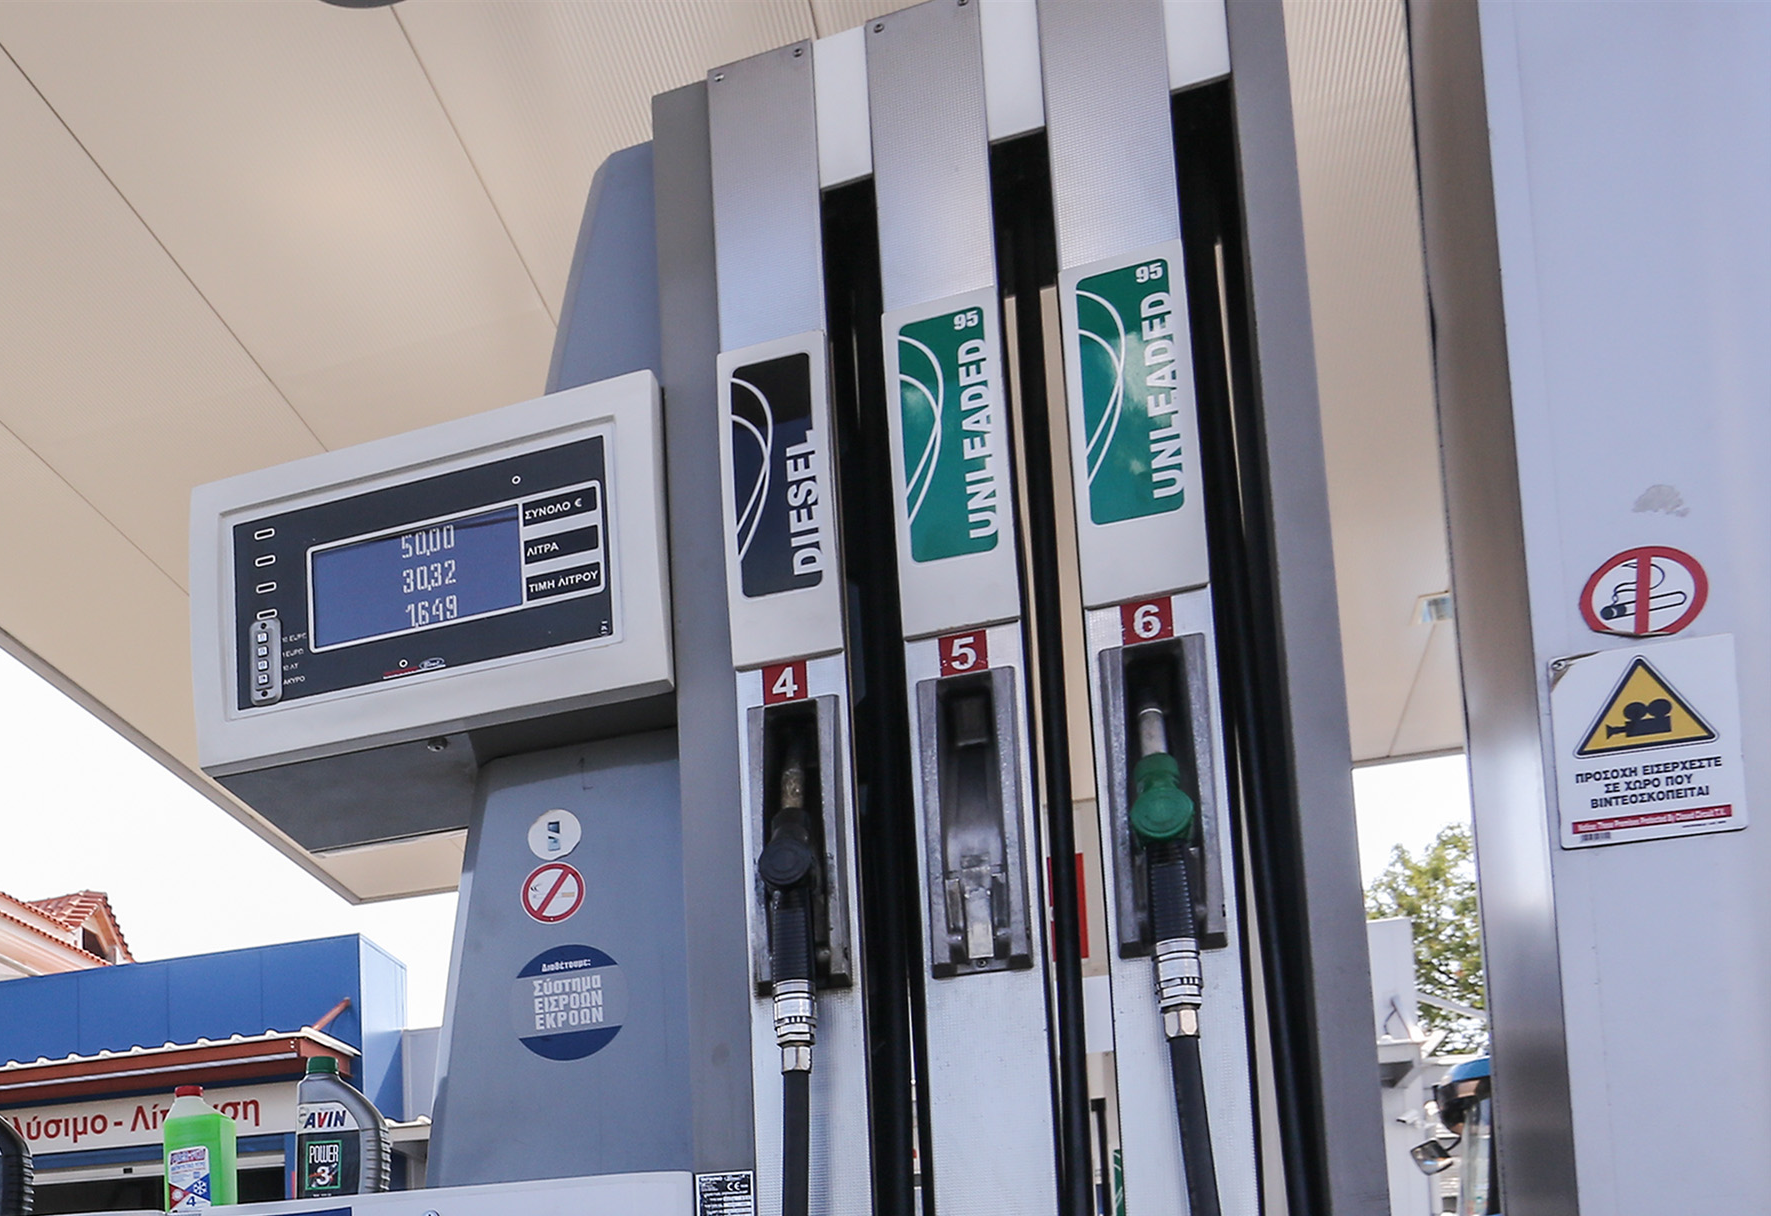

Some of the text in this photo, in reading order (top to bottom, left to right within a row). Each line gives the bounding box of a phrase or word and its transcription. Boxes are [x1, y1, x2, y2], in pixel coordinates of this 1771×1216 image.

[1136, 263, 1163, 283] 95
[953, 311, 979, 331] 95
[1140, 291, 1184, 499] UNLEADED
[957, 338, 999, 539] UNLEADED
[525, 498, 583, 520] ΣΥΝΟΛΟ €
[786, 429, 824, 576] DIESEL
[400, 524, 456, 559] 50,00
[527, 541, 560, 557] ΛΙΤΡΑ
[402, 560, 457, 594] 30,32
[529, 570, 599, 593] ΤΙΜΗ ΛΙΤΡΟΥ
[1132, 604, 1162, 638] 6
[950, 637, 977, 671] 5
[772, 666, 799, 698] 4
[1575, 756, 1723, 784] ΠΡΟΣΟΧΗ ΕΙΣΕΡΧΕΣΤΕ
[1604, 774, 1693, 794] ΣΕ ΧΩΡΟ ΠΟΥ
[1591, 786, 1710, 809] ΒΙΝΤΕΟΣΚΟΠΕΙΤΑΙ
[533, 974, 602, 997] Σύστημα
[534, 990, 603, 1014] ΕΙΣΡΟΩΝ
[535, 1006, 604, 1031] ΕΚΡΟΩΝ
[304, 1110, 347, 1129] AVIN
[309, 1144, 340, 1164] POWER
[316, 1165, 331, 1186] 3
[186, 1195, 197, 1207] 4
